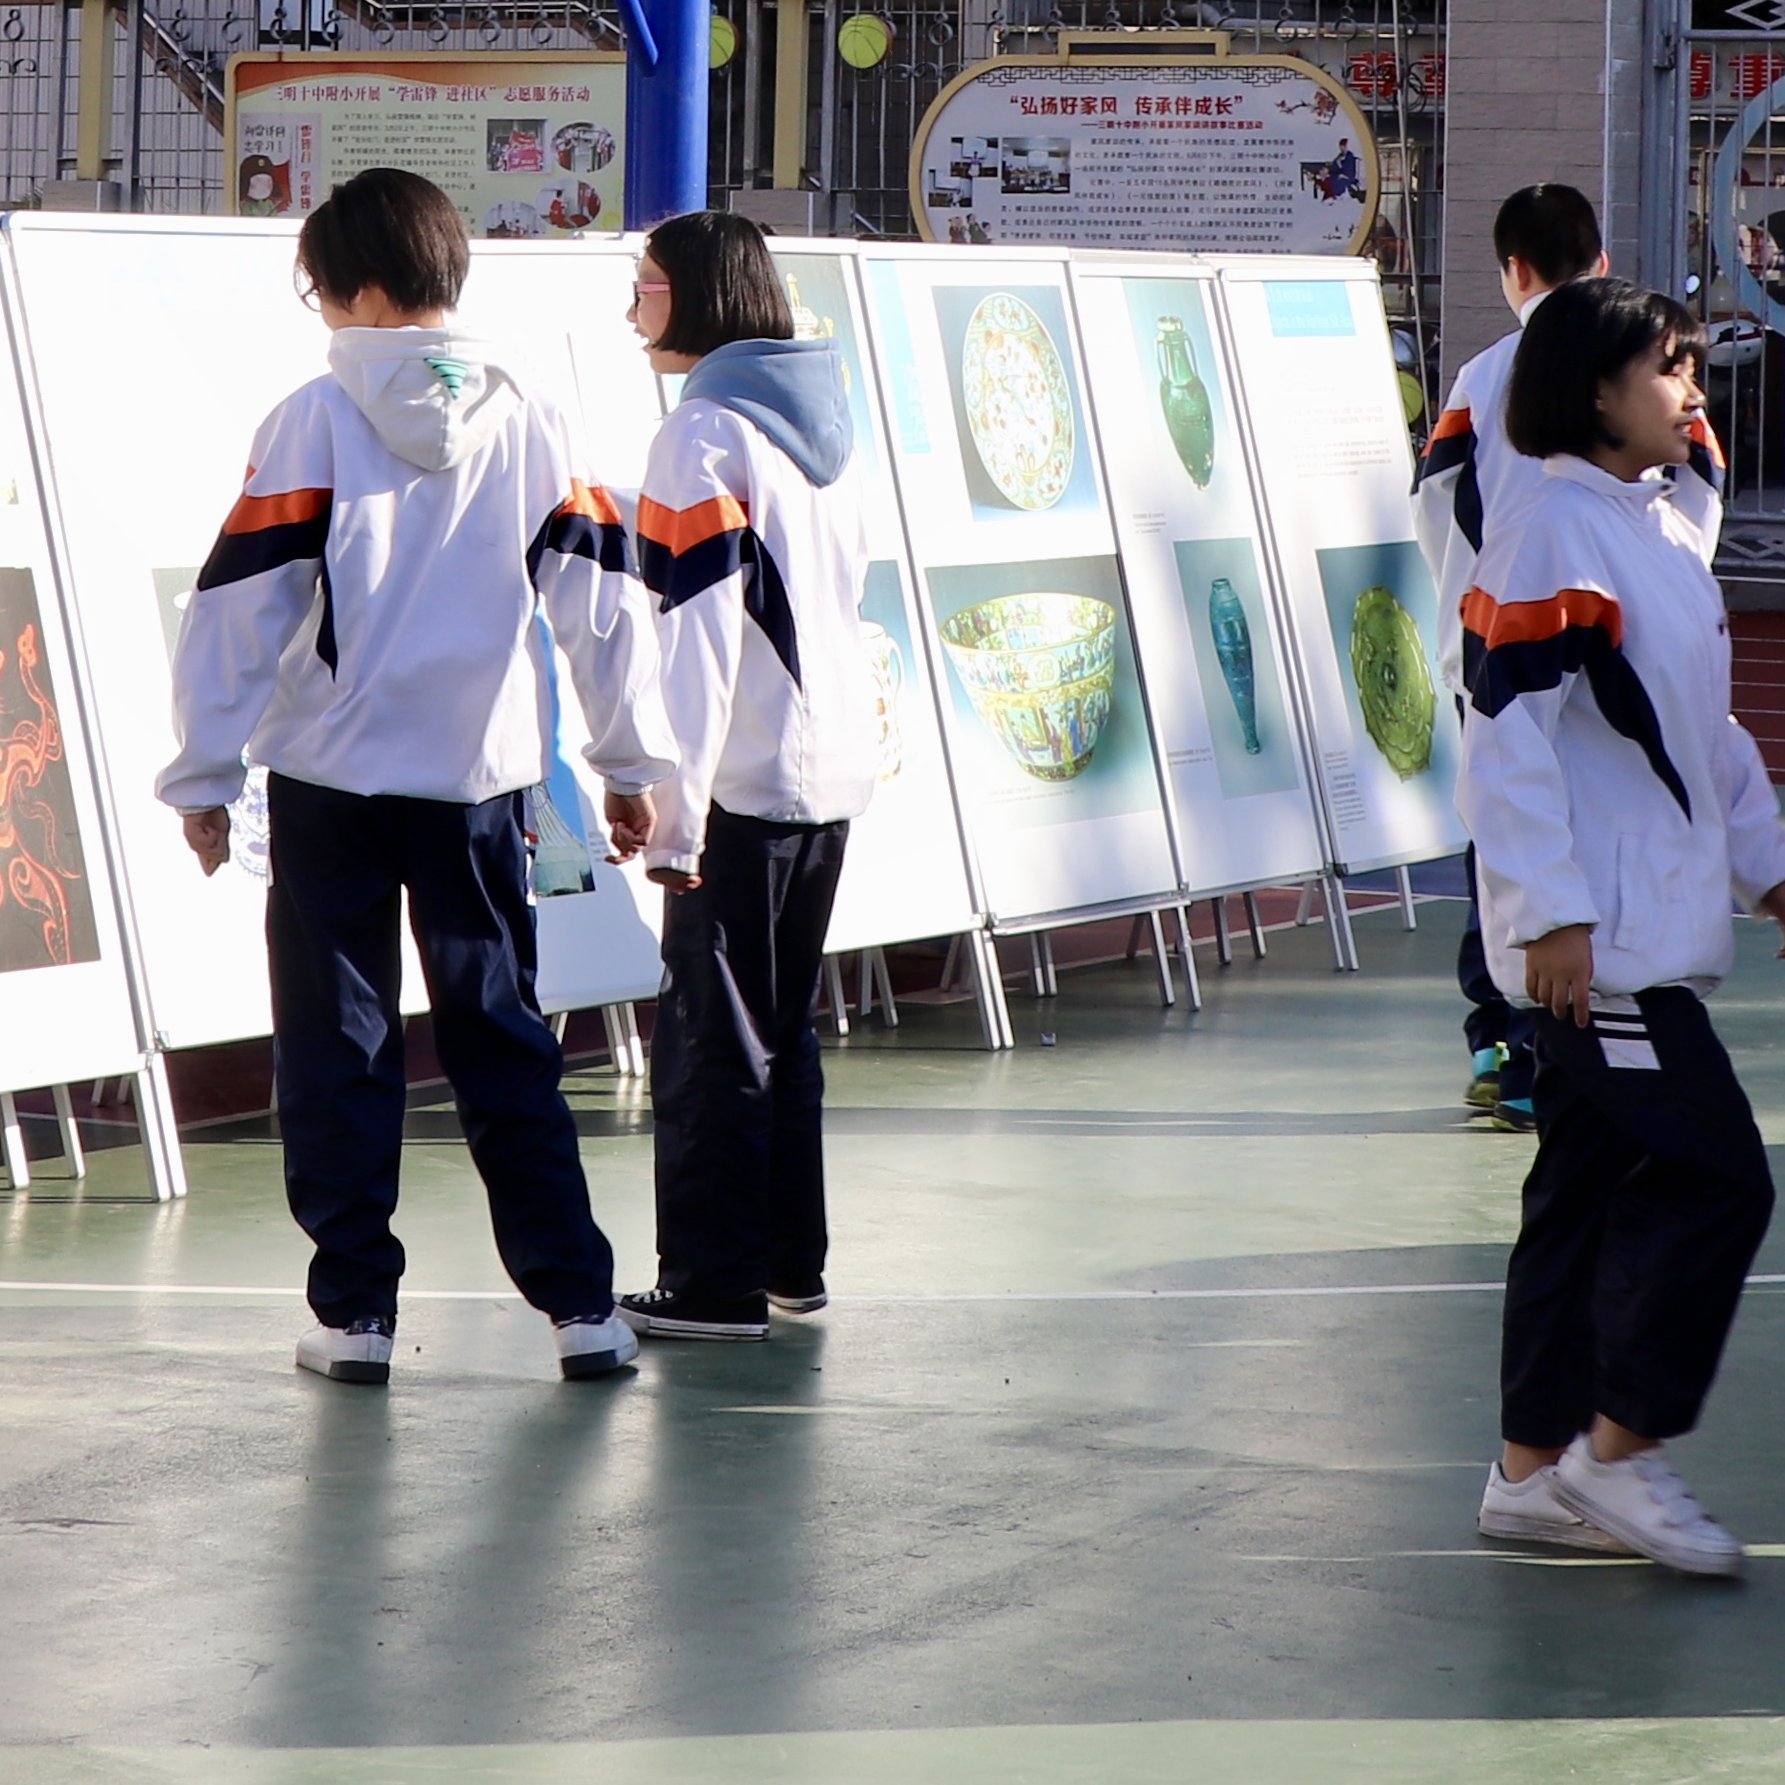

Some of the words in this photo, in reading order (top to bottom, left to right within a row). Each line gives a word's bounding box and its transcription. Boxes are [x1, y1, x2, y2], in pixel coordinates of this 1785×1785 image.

[1010, 95, 1118, 116] “弘扬好家风
[1135, 95, 1243, 116] 传承伴成长”
